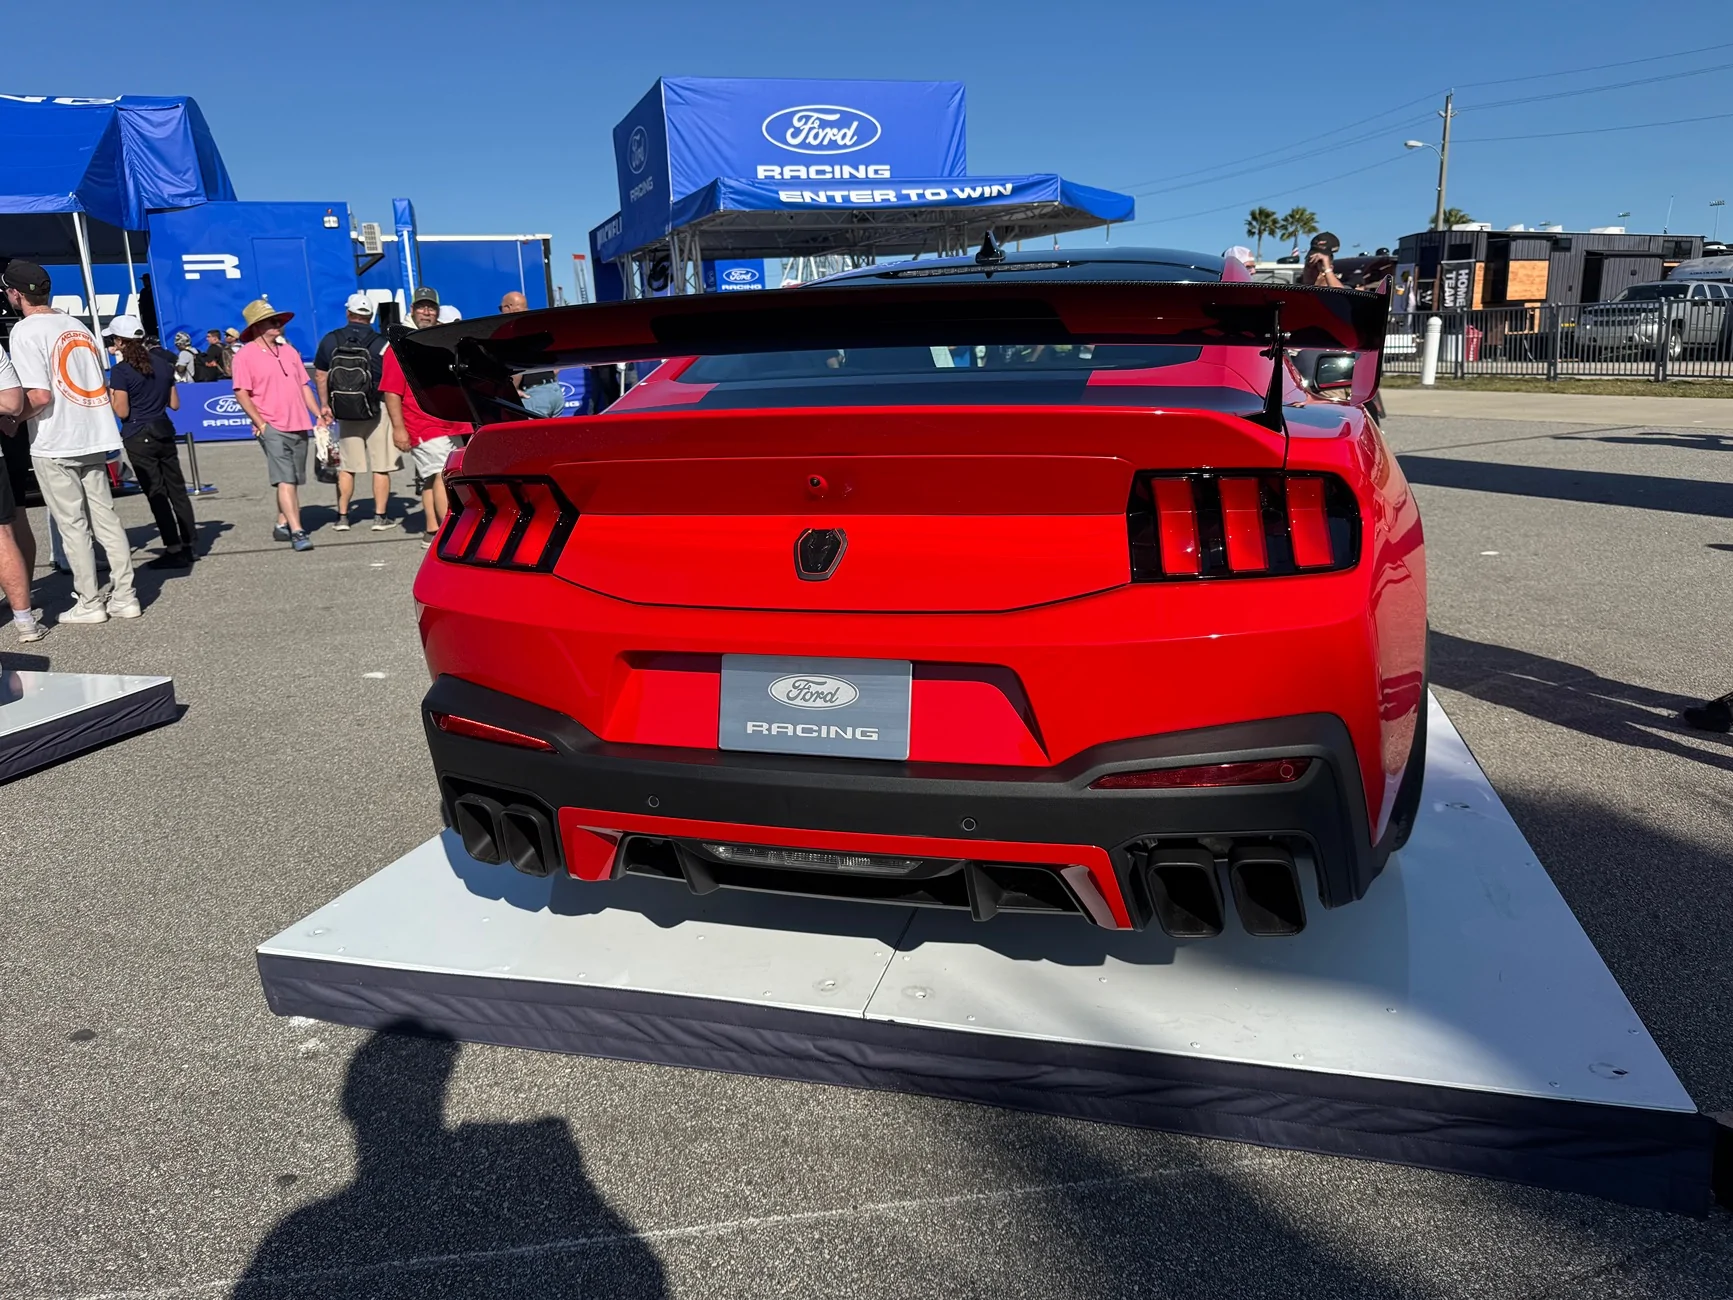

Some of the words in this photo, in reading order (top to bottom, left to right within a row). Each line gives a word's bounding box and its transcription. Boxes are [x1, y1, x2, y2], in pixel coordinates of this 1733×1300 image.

[785, 111, 859, 146] Ford
[757, 164, 891, 180] RACING
[778, 190, 898, 203] ENTER
[902, 187, 948, 202] TO
[952, 183, 1013, 200] WIN
[729, 269, 753, 281] Ford
[721, 283, 763, 291] RACING
[1443, 270, 1457, 308] TEAM
[1456, 268, 1470, 307] HOME
[216, 397, 243, 412] For
[785, 678, 841, 704] Ford
[746, 721, 879, 741] RACING
